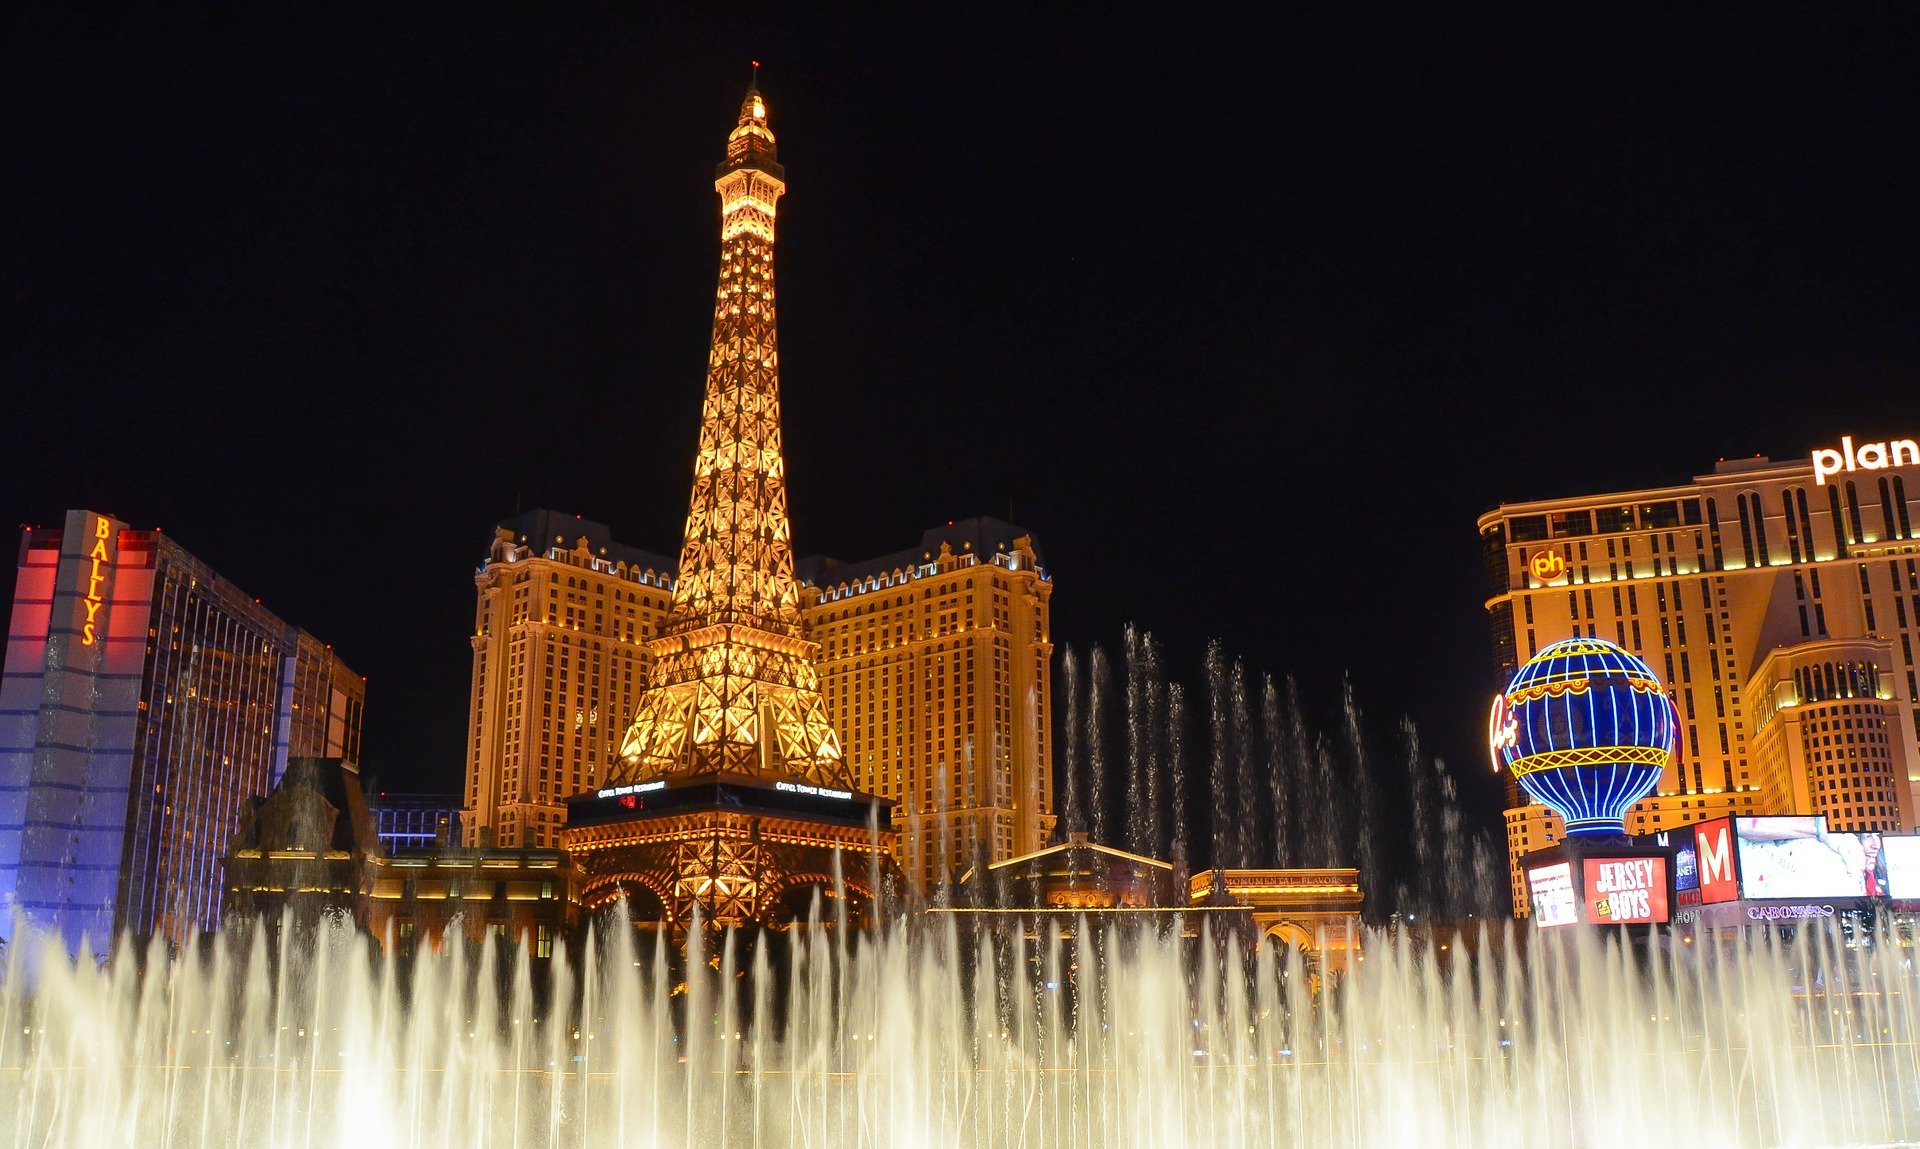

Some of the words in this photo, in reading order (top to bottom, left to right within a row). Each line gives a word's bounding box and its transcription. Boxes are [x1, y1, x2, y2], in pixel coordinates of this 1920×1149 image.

[1812, 436, 1920, 485] plan
[1535, 550, 1564, 577] ph
[1698, 827, 1731, 885] M
[1225, 877, 1295, 885] MONUMENTAL
[1302, 876, 1343, 884] FLAVORS
[1596, 859, 1653, 893] JERSEY
[1608, 889, 1651, 922] BOYS
[1748, 906, 1792, 921] CABO
